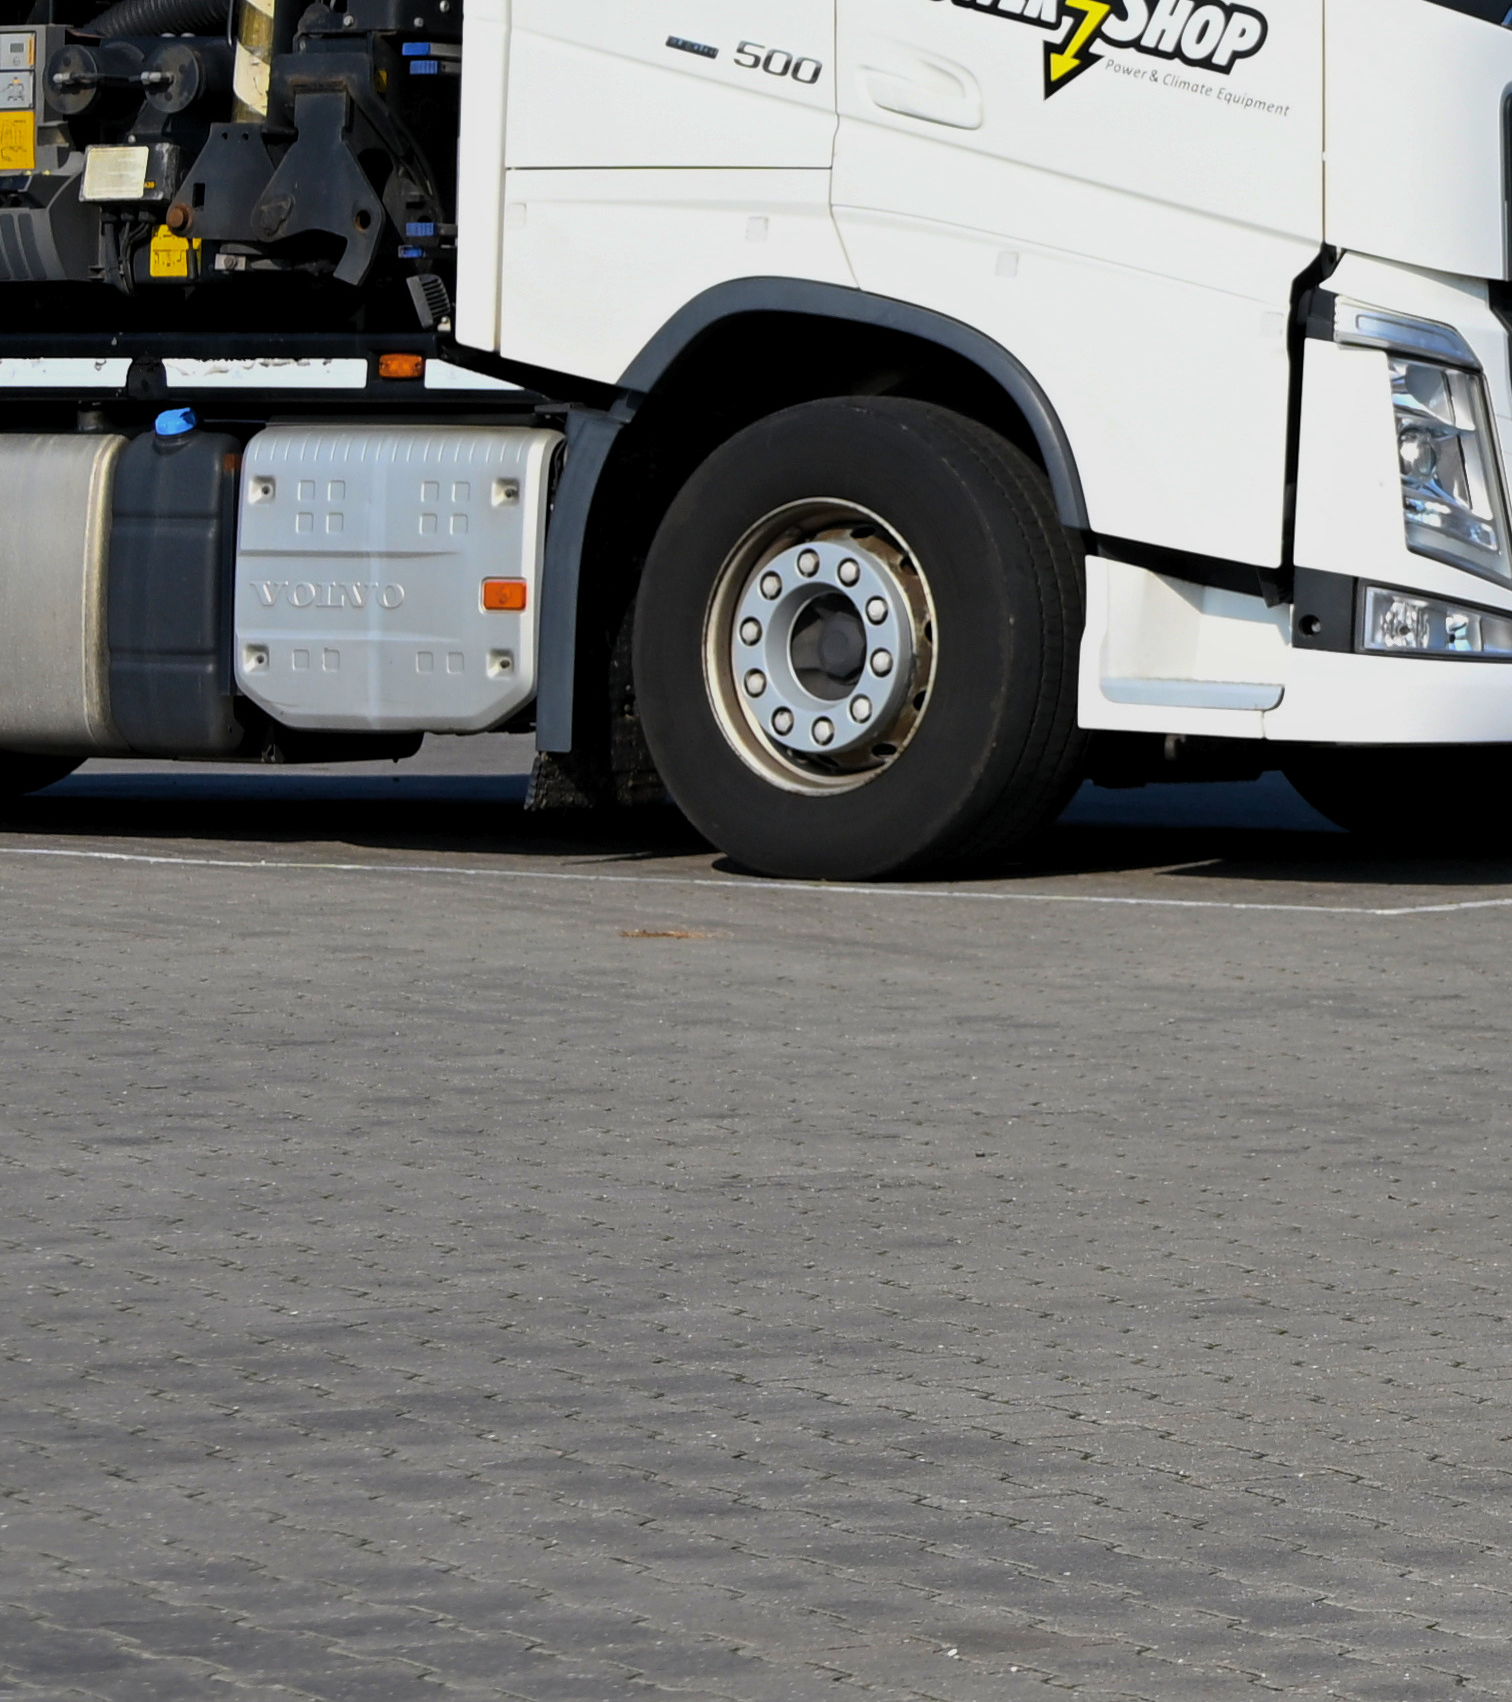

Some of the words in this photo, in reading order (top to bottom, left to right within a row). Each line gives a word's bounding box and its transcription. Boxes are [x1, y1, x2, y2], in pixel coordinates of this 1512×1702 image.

[733, 40, 823, 85] 500
[1105, 58, 1147, 80] Power
[1149, 69, 1159, 83] &
[1162, 73, 1213, 98] Climate
[1216, 87, 1290, 117] Equipment
[250, 580, 406, 610] VOLVO
